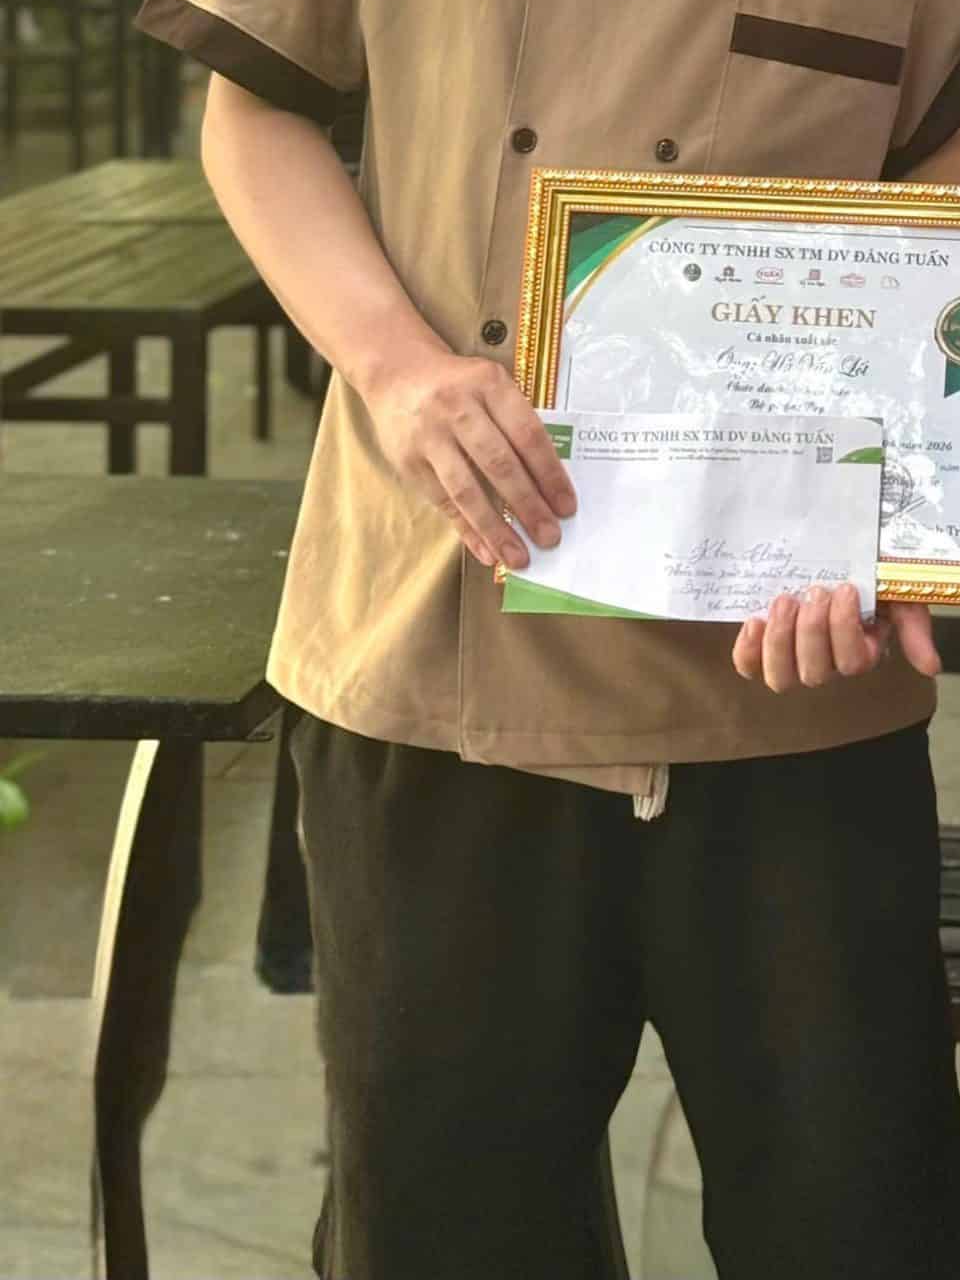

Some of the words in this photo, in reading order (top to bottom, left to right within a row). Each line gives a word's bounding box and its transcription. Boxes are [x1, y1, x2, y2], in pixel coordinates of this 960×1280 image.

[649, 238, 694, 254] CÔNG
[700, 243, 720, 255] TY
[723, 244, 770, 258] TNHH
[775, 246, 795, 259] SX
[799, 248, 822, 261] TM
[828, 249, 850, 261] DV
[905, 249, 950, 267] TUẤN
[711, 295, 784, 325] GIẤY
[792, 305, 877, 328] KHEN
[578, 426, 618, 441] CÔNG
[622, 431, 640, 442] TY
[641, 431, 679, 442] TNHH
[683, 430, 700, 441] SX
[704, 430, 724, 441] TM
[728, 431, 750, 442] DV
[926, 440, 952, 451] 2026
